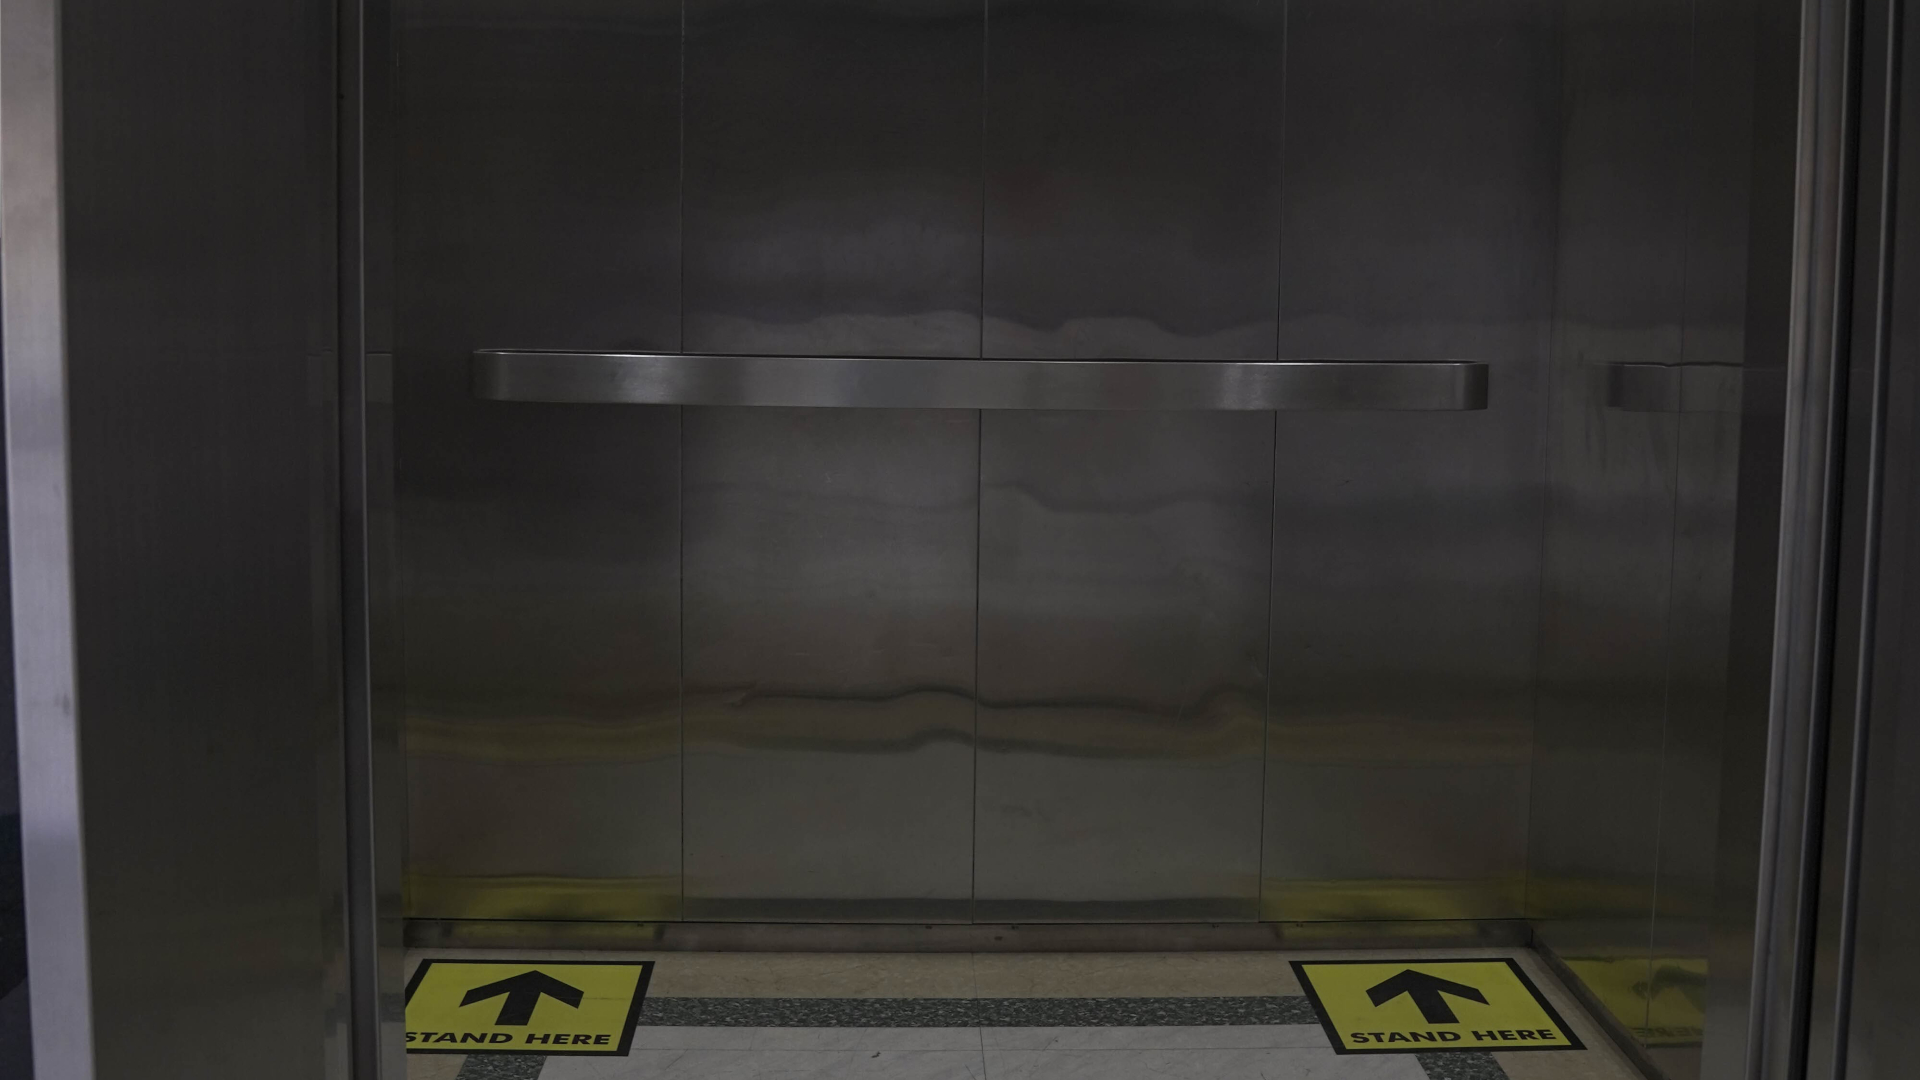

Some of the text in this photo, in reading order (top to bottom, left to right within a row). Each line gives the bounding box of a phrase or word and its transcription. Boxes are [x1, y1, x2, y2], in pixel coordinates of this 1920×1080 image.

[406, 1031, 611, 1045] STAND HERE
[1350, 1029, 1557, 1043] STAND HERE
